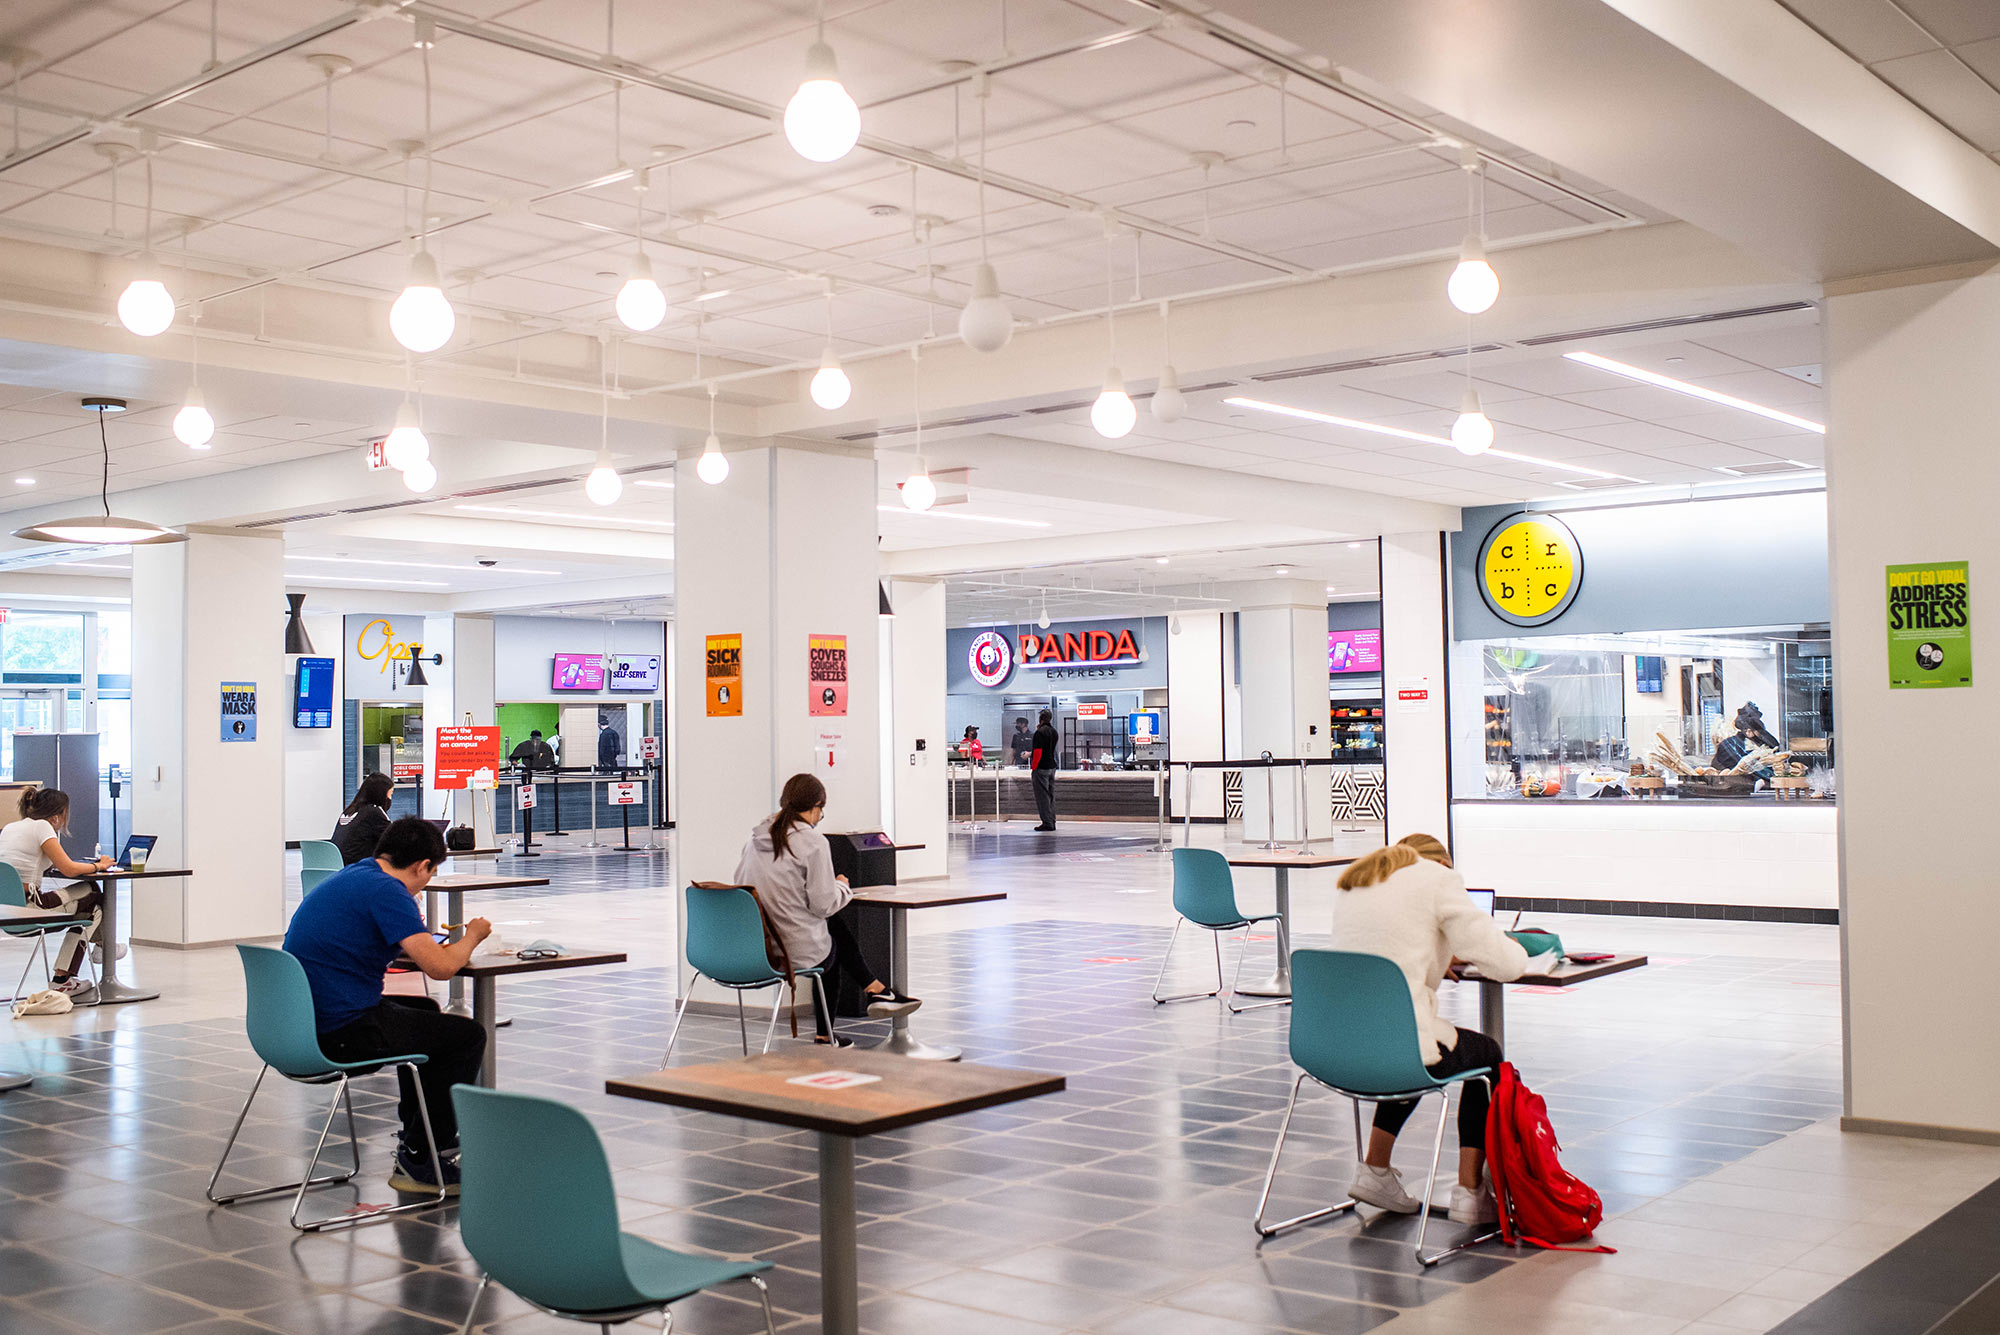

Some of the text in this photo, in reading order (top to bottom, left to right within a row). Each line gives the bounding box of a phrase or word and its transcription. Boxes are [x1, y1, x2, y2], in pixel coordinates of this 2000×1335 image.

[1501, 543, 1557, 558] c r
[1920, 570, 1935, 586] GO
[1501, 582, 1557, 599] b c
[1890, 583, 1966, 602] ADDRESS
[1890, 600, 1967, 630] STRESS
[357, 618, 424, 674] Ope
[1019, 630, 1138, 664] PANDA
[707, 648, 740, 664] SICK
[810, 648, 846, 661] COVER
[811, 661, 846, 671] COUGHS &
[1046, 667, 1115, 678] EXPRESS
[811, 671, 846, 681] SNEEZES
[222, 692, 256, 702] WEAR A
[222, 702, 256, 715] MASK
